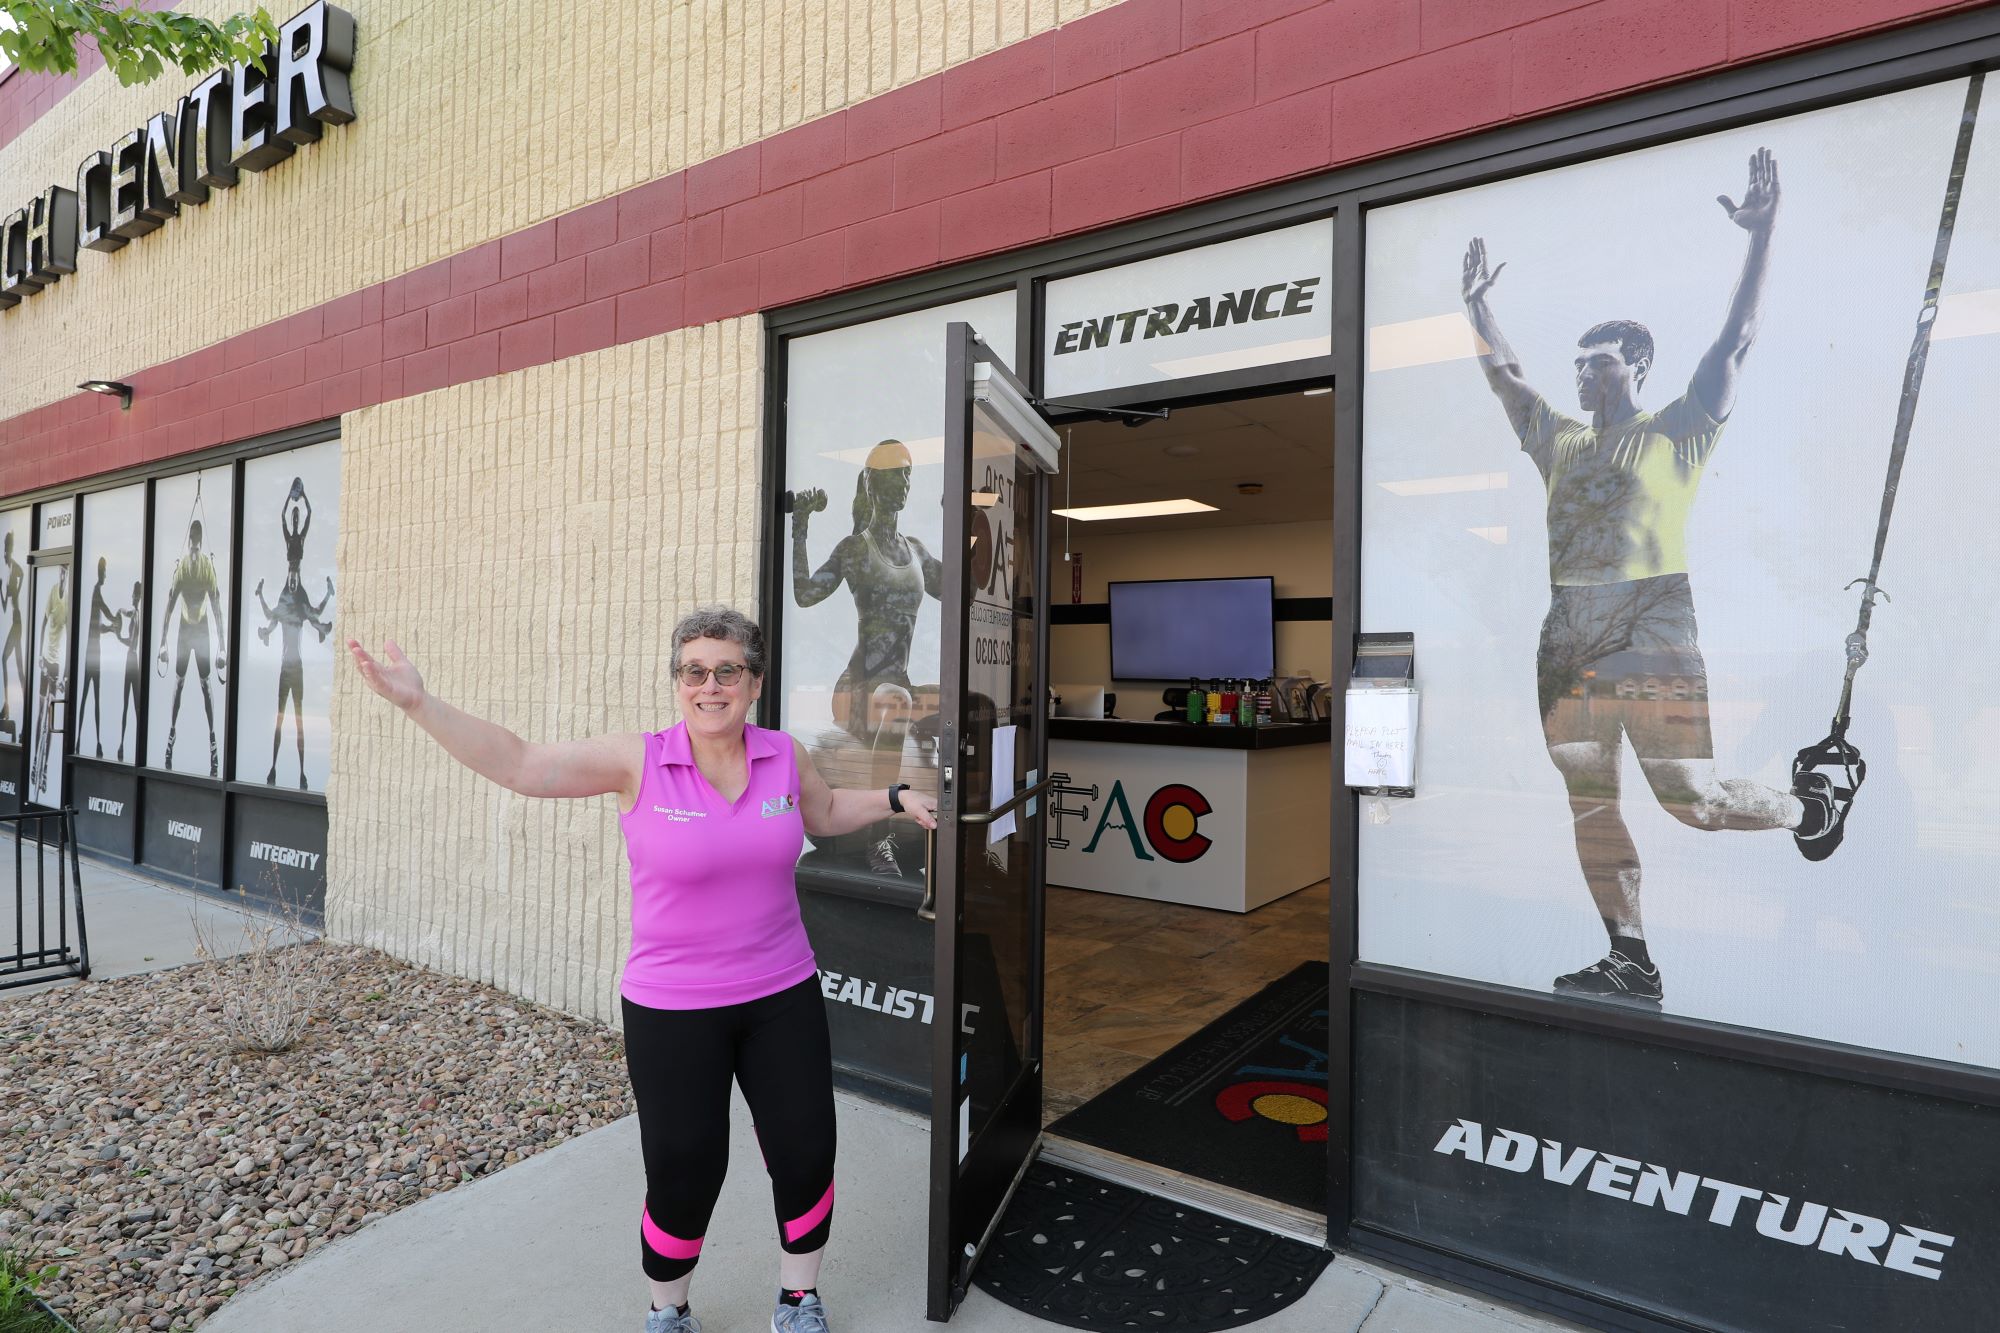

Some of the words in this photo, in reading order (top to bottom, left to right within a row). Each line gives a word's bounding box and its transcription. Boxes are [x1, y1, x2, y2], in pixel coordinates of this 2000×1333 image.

[77, 0, 342, 252] CENTER
[1053, 277, 1321, 356] ENTRANCE
[47, 513, 72, 530] POWER
[88, 796, 124, 817] VICTORY
[653, 805, 673, 814] Susan
[667, 814, 691, 823] Owner
[168, 819, 202, 843] VISION
[249, 840, 320, 872] INTEGRITY
[1433, 1117, 1956, 1281] ADVENTURE
